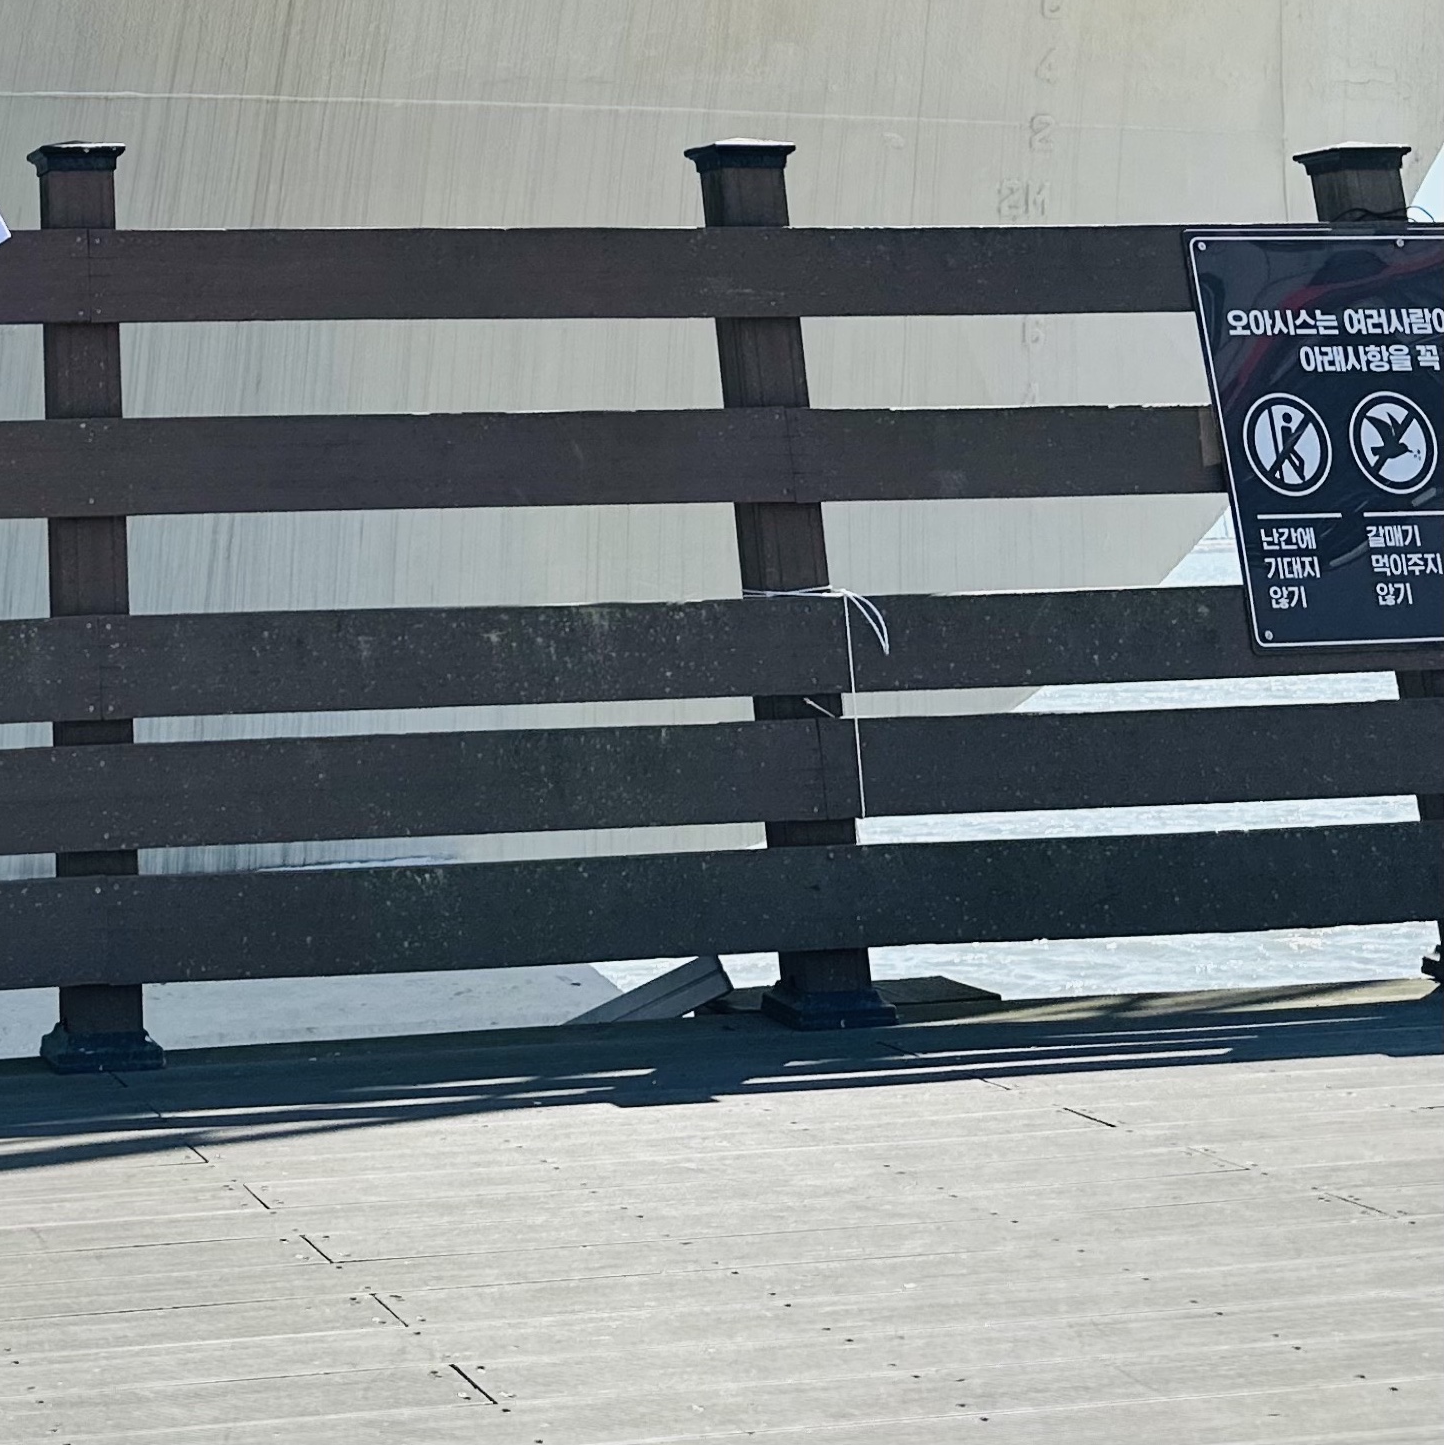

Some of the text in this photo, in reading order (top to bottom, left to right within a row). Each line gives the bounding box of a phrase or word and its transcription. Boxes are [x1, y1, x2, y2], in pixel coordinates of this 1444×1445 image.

[1226, 309, 1339, 336] 오아시스는
[1299, 344, 1441, 372] 아래사항을 꼭
[1260, 527, 1317, 550] 난간에
[1366, 525, 1422, 548] 갈매기
[1264, 556, 1321, 579] 기대지
[1371, 553, 1444, 576] 먹이주지
[1269, 585, 1308, 609] 않기
[1376, 582, 1413, 606] 않기
